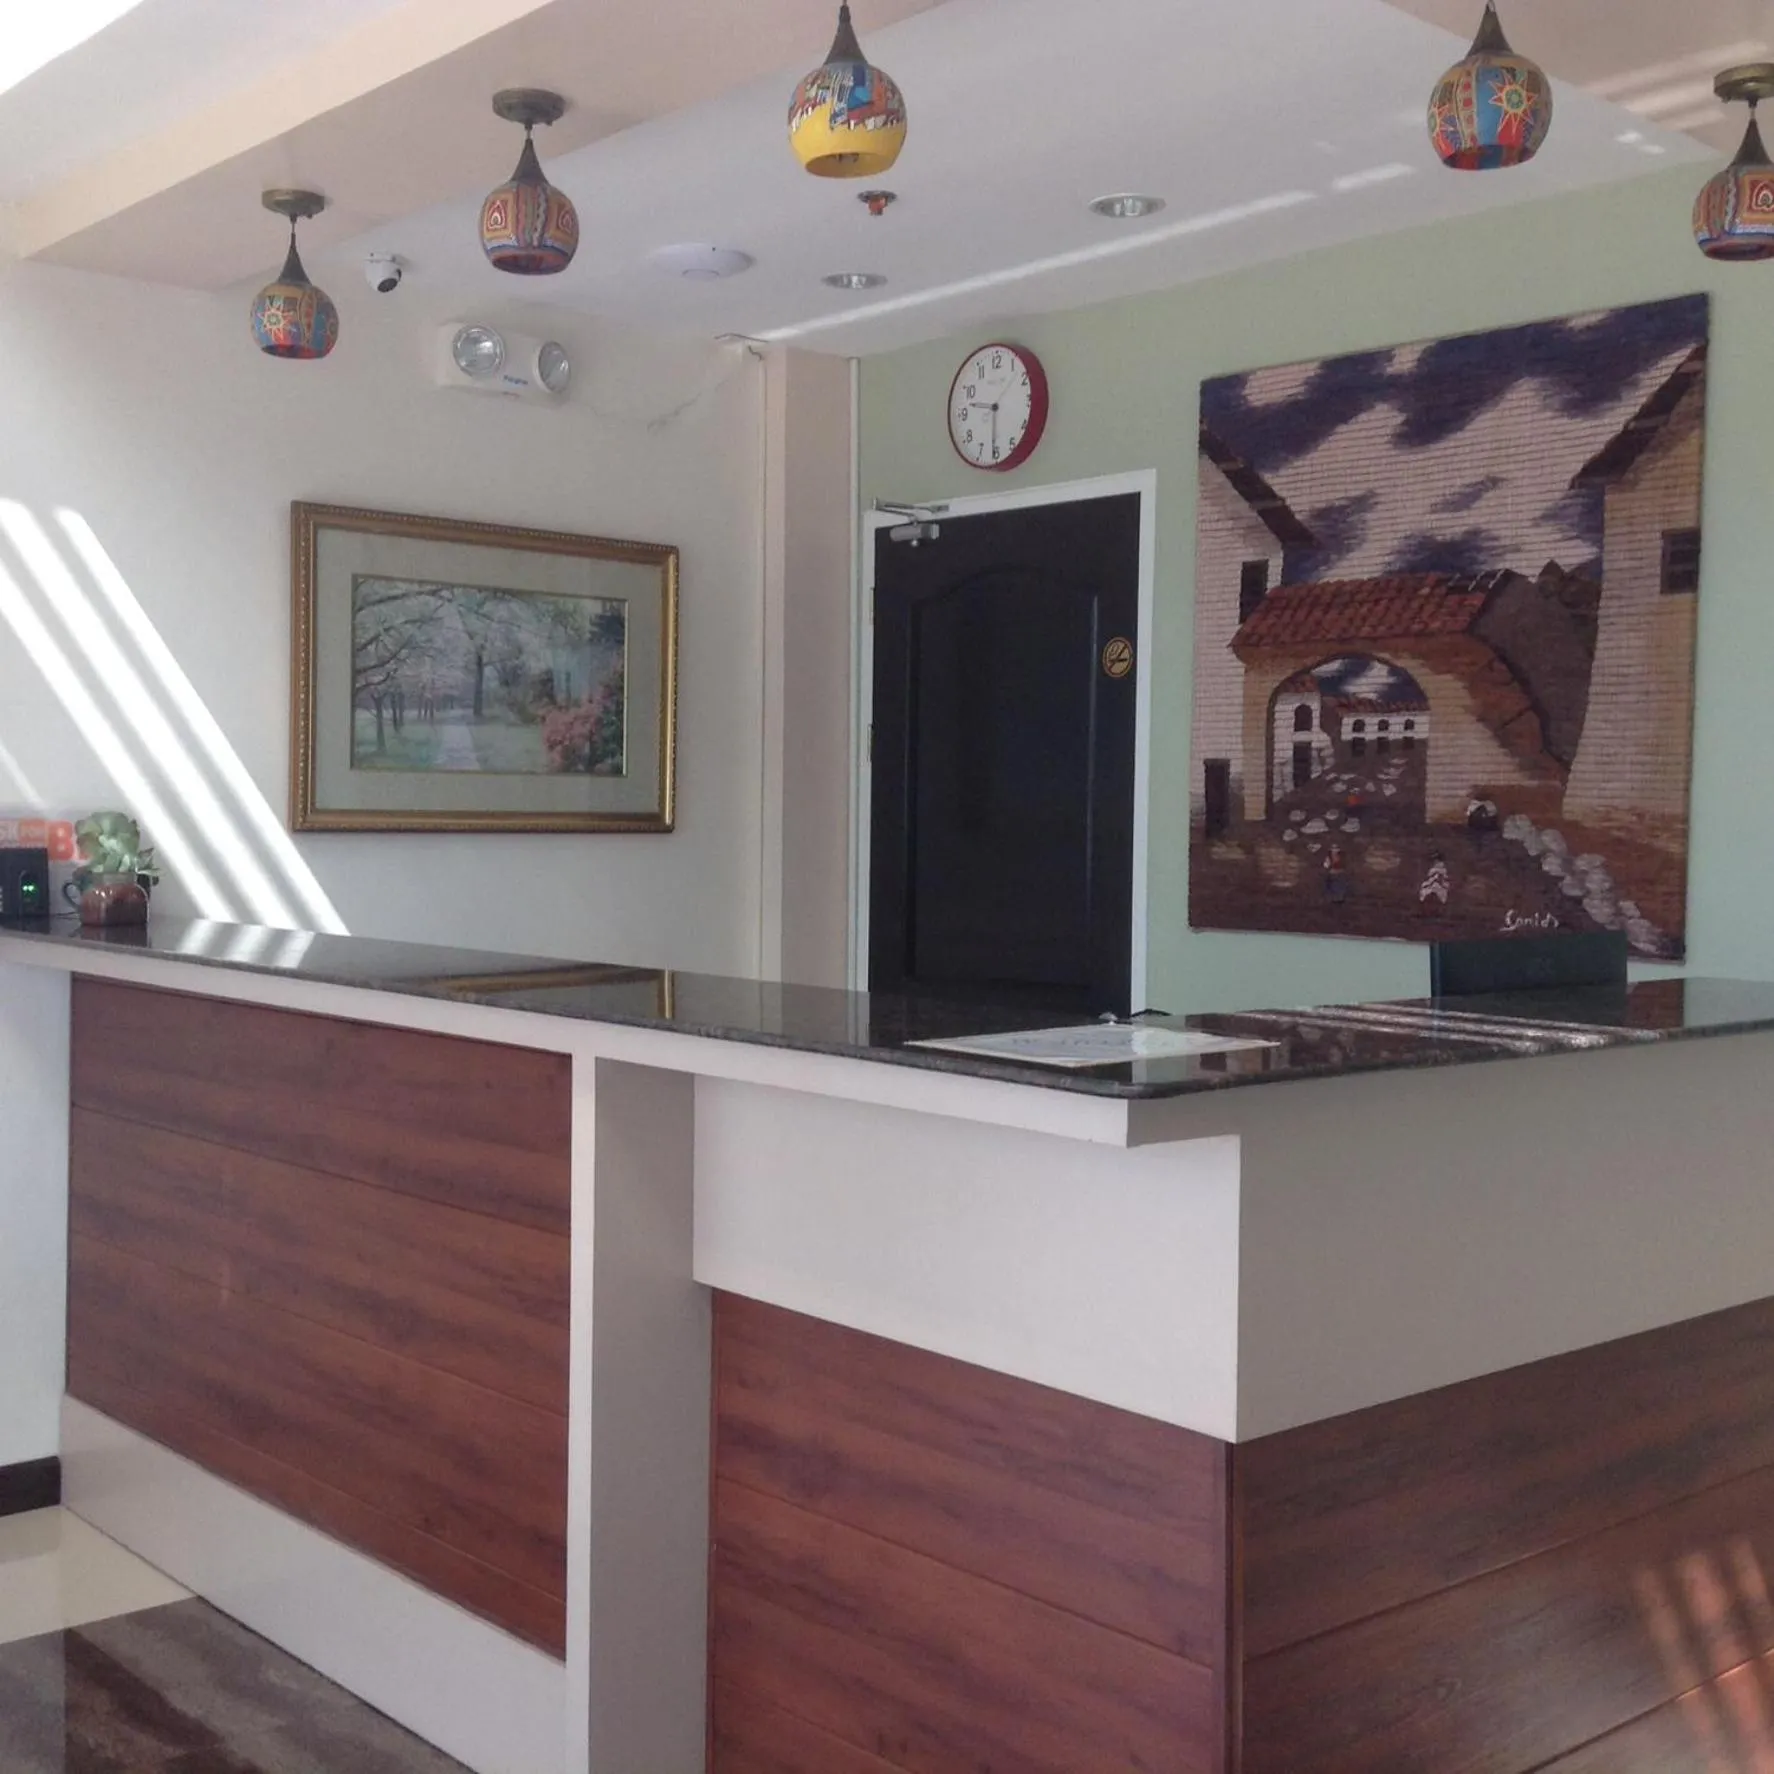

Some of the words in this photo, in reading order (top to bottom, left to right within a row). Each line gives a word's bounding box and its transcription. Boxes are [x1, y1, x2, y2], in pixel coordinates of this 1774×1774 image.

[991, 355, 1002, 369] 12
[978, 364, 985, 379] 11
[1020, 372, 1029, 386] 2
[965, 385, 976, 399] 10
[961, 407, 969, 421] 9
[966, 429, 973, 444] 8
[978, 442, 985, 457] 7
[1009, 437, 1016, 451] 5
